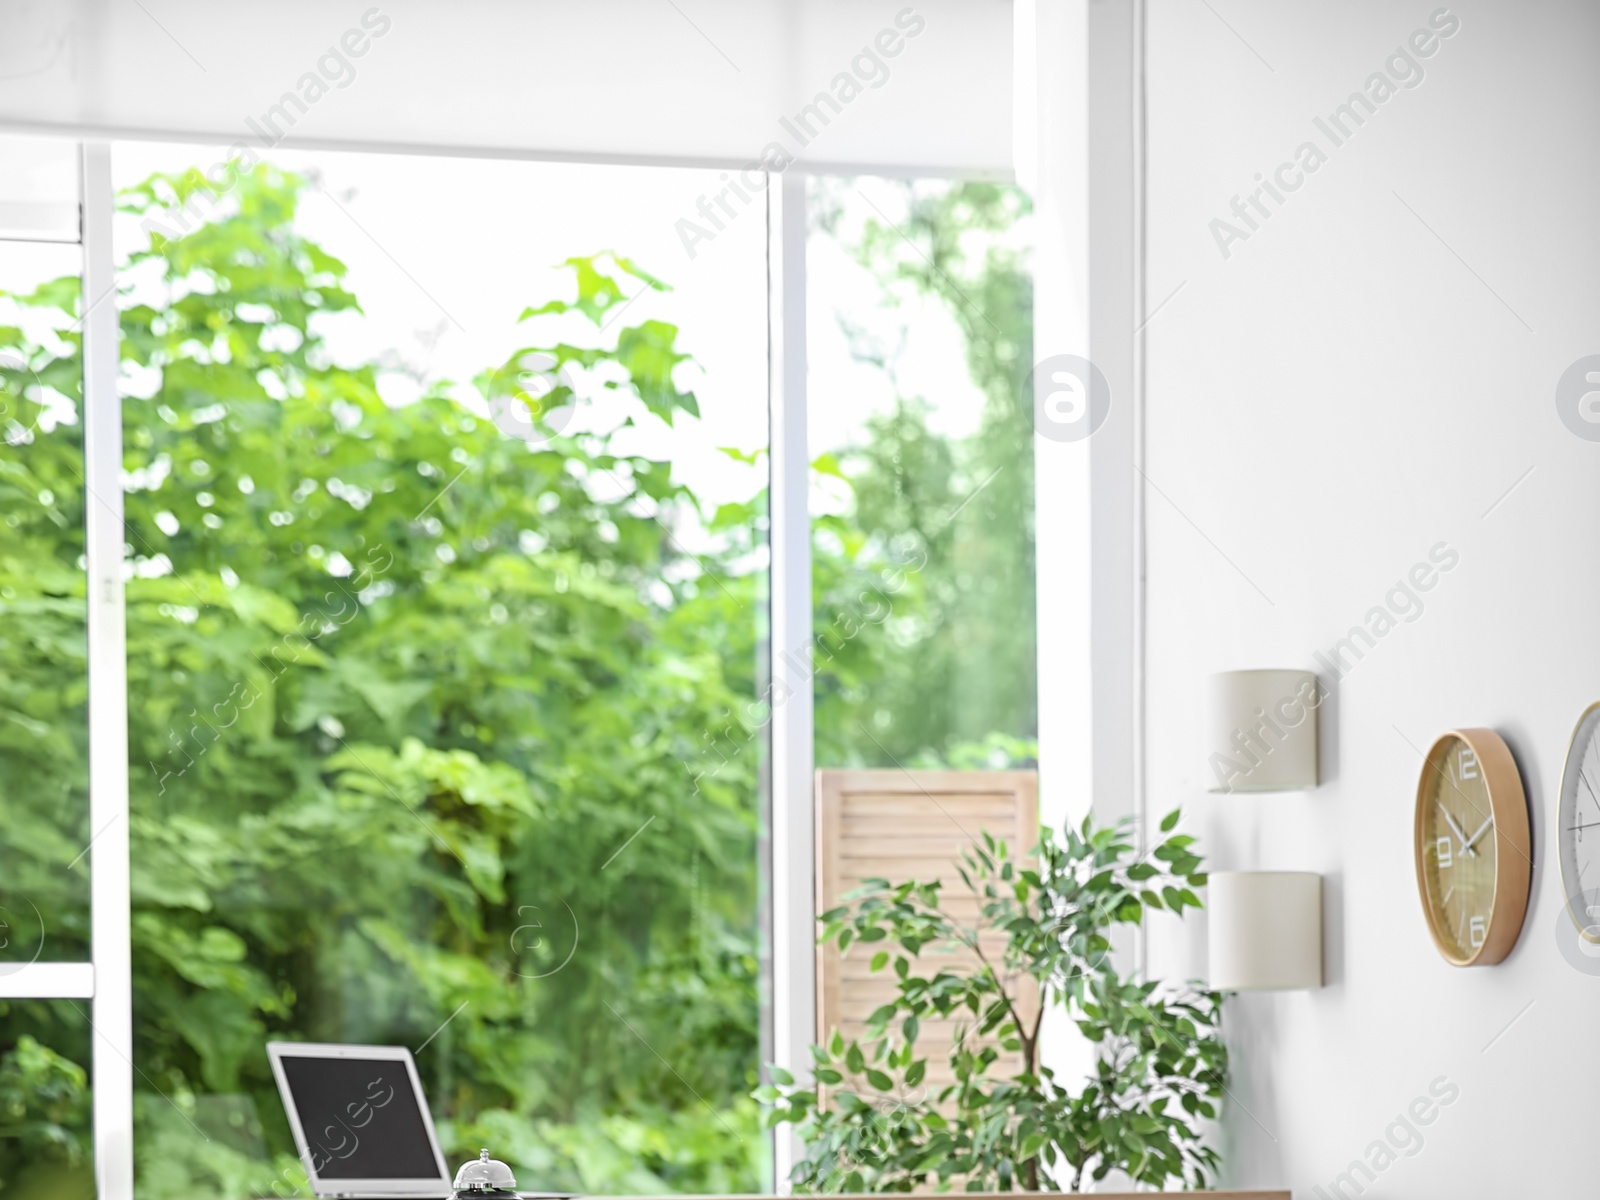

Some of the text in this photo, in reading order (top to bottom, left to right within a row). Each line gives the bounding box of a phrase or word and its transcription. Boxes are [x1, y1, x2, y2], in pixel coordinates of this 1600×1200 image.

[1458, 748, 1478, 780] 12
[1436, 836, 1453, 868] 9
[1469, 915, 1486, 948] 6
